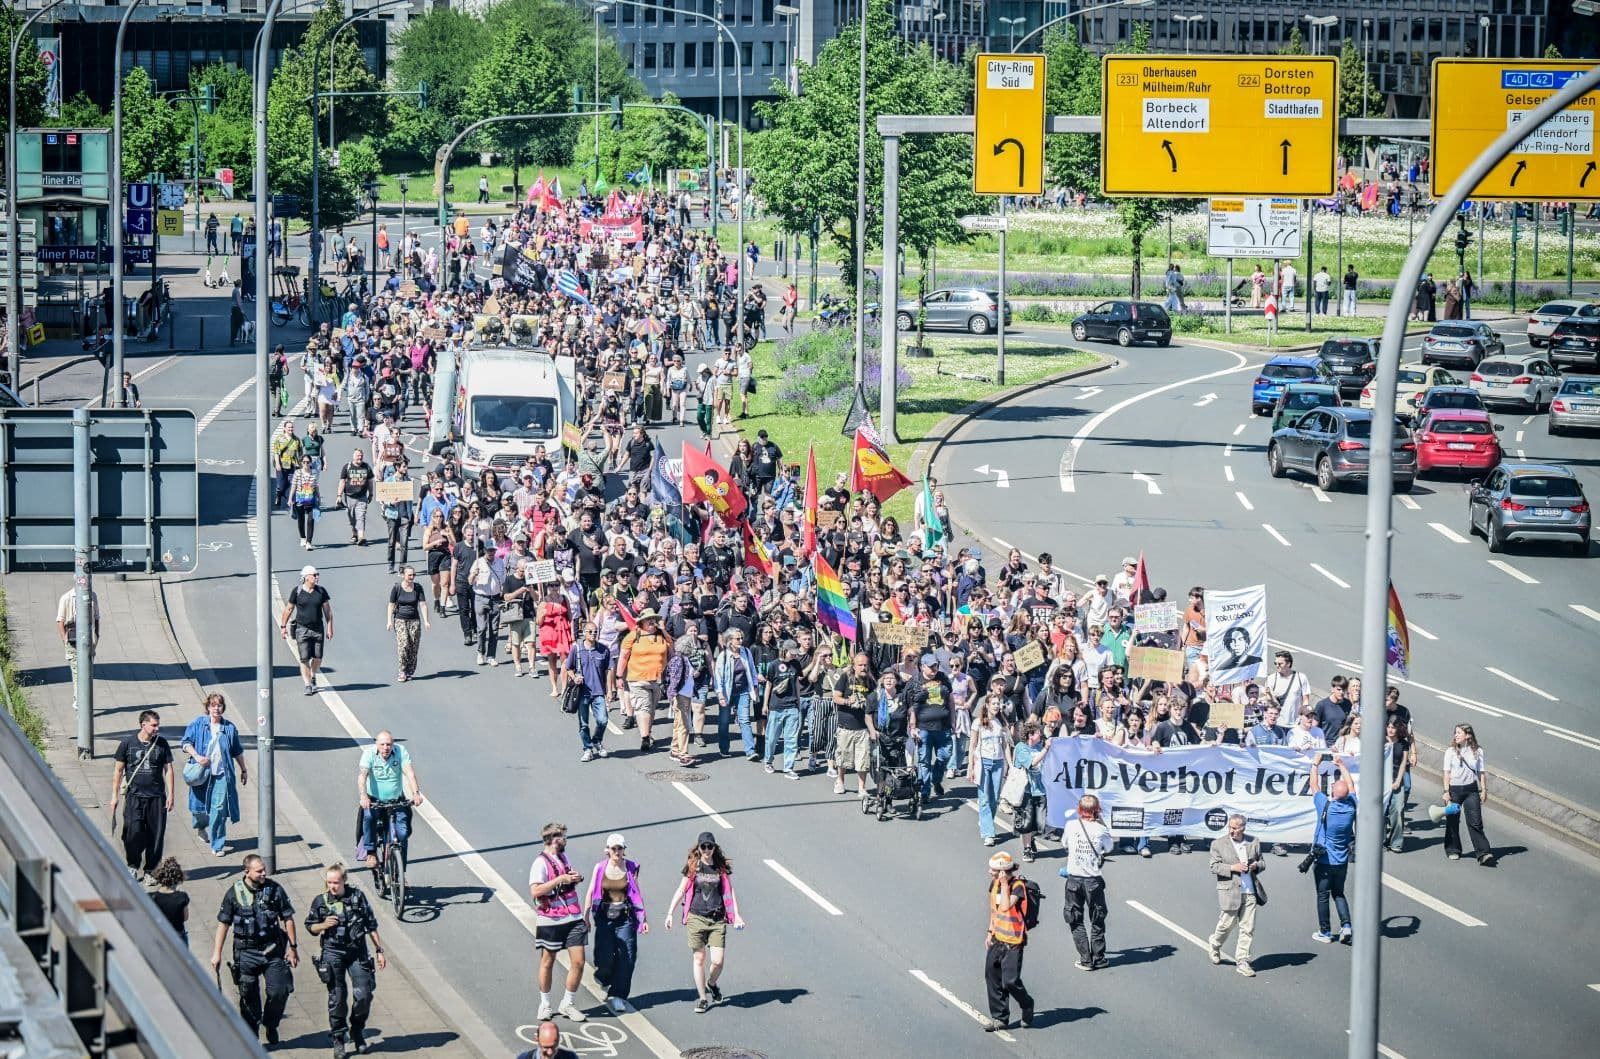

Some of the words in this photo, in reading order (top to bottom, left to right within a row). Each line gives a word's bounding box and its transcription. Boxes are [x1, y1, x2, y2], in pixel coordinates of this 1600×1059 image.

[988, 61, 1034, 76] City-Ring
[1143, 66, 1197, 78] Oberhausen
[1265, 67, 1314, 79] Dorsten
[1001, 76, 1020, 88] Süd
[1120, 75, 1136, 84] 231
[1240, 76, 1258, 85] 224
[1511, 75, 1523, 84] 40
[1536, 75, 1548, 84] 42
[1143, 81, 1211, 93] Mülheim/Ruhr
[1264, 83, 1311, 97] Bottrop
[1146, 102, 1198, 113] Borbeck
[1268, 103, 1319, 115] Stadthafen
[1146, 118, 1205, 129] Altendorf
[1515, 142, 1590, 153] ity-Ring-Nord
[42, 175, 64, 185] rliner
[131, 185, 148, 207] U
[38, 248, 66, 260] rliner
[69, 248, 96, 260] Platz
[1053, 758, 1236, 795] AfD-Verbot
